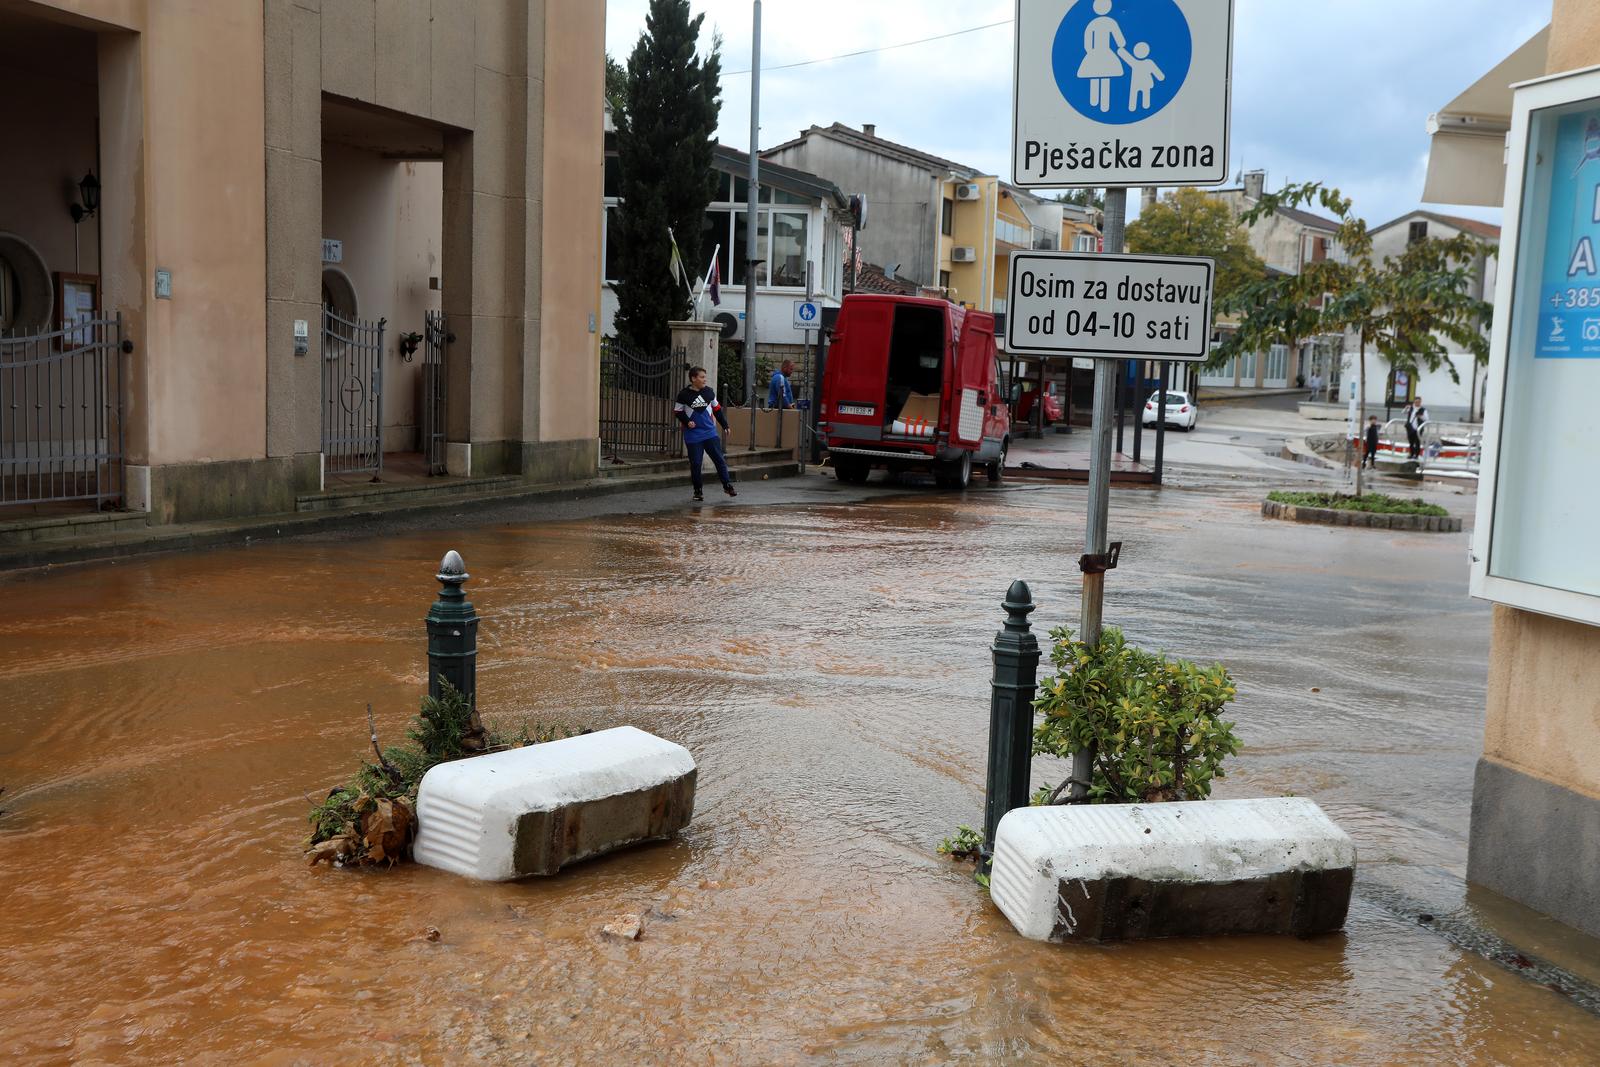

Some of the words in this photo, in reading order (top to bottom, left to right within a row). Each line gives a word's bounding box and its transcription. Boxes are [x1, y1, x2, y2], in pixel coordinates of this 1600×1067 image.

[1024, 138, 1142, 178] Pješačka
[1151, 144, 1214, 168] zona
[1020, 270, 1075, 299] Osim
[1083, 279, 1108, 300] za
[1117, 275, 1202, 305] dostavu
[1028, 309, 1054, 335] od
[1066, 310, 1136, 338] 04-10
[1146, 315, 1190, 341] sati
